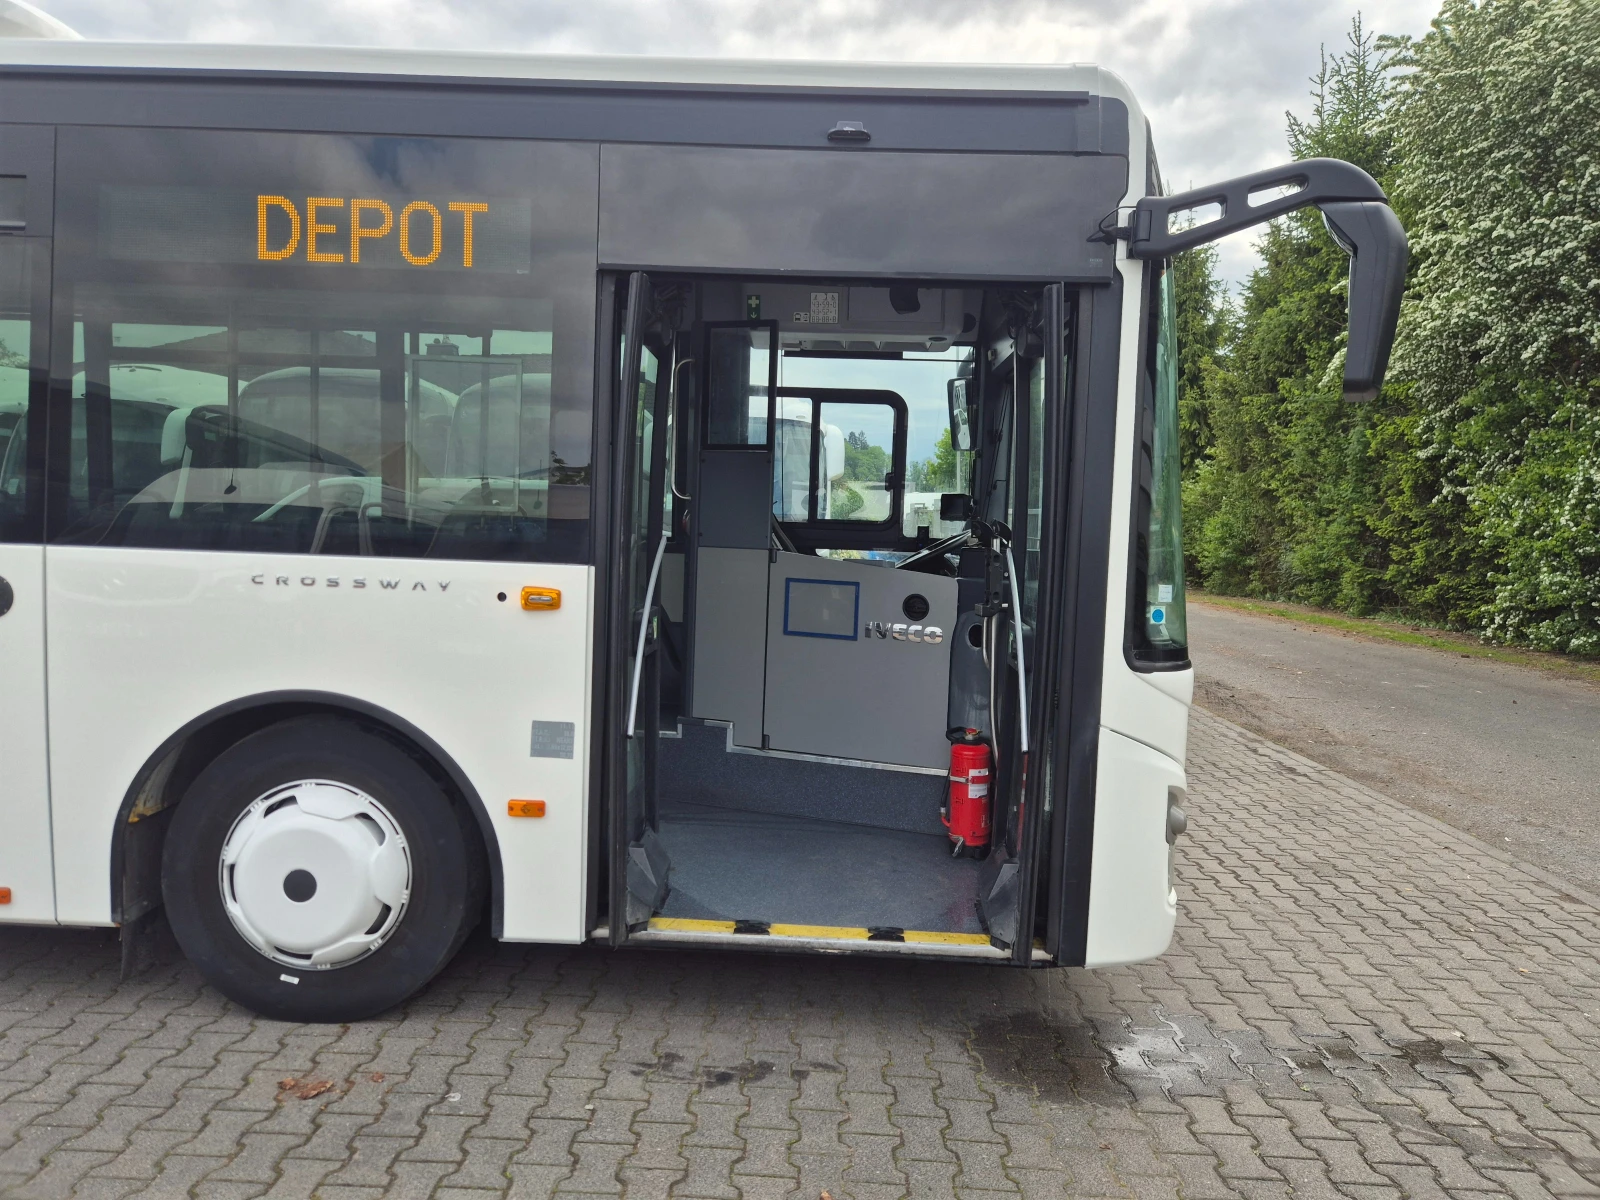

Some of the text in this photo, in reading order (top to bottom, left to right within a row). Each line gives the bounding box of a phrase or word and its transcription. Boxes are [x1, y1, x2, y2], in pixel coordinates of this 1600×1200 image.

[257, 195, 489, 267] DEPOT
[251, 574, 451, 592] CROSSWAY
[865, 621, 943, 645] IVECO
